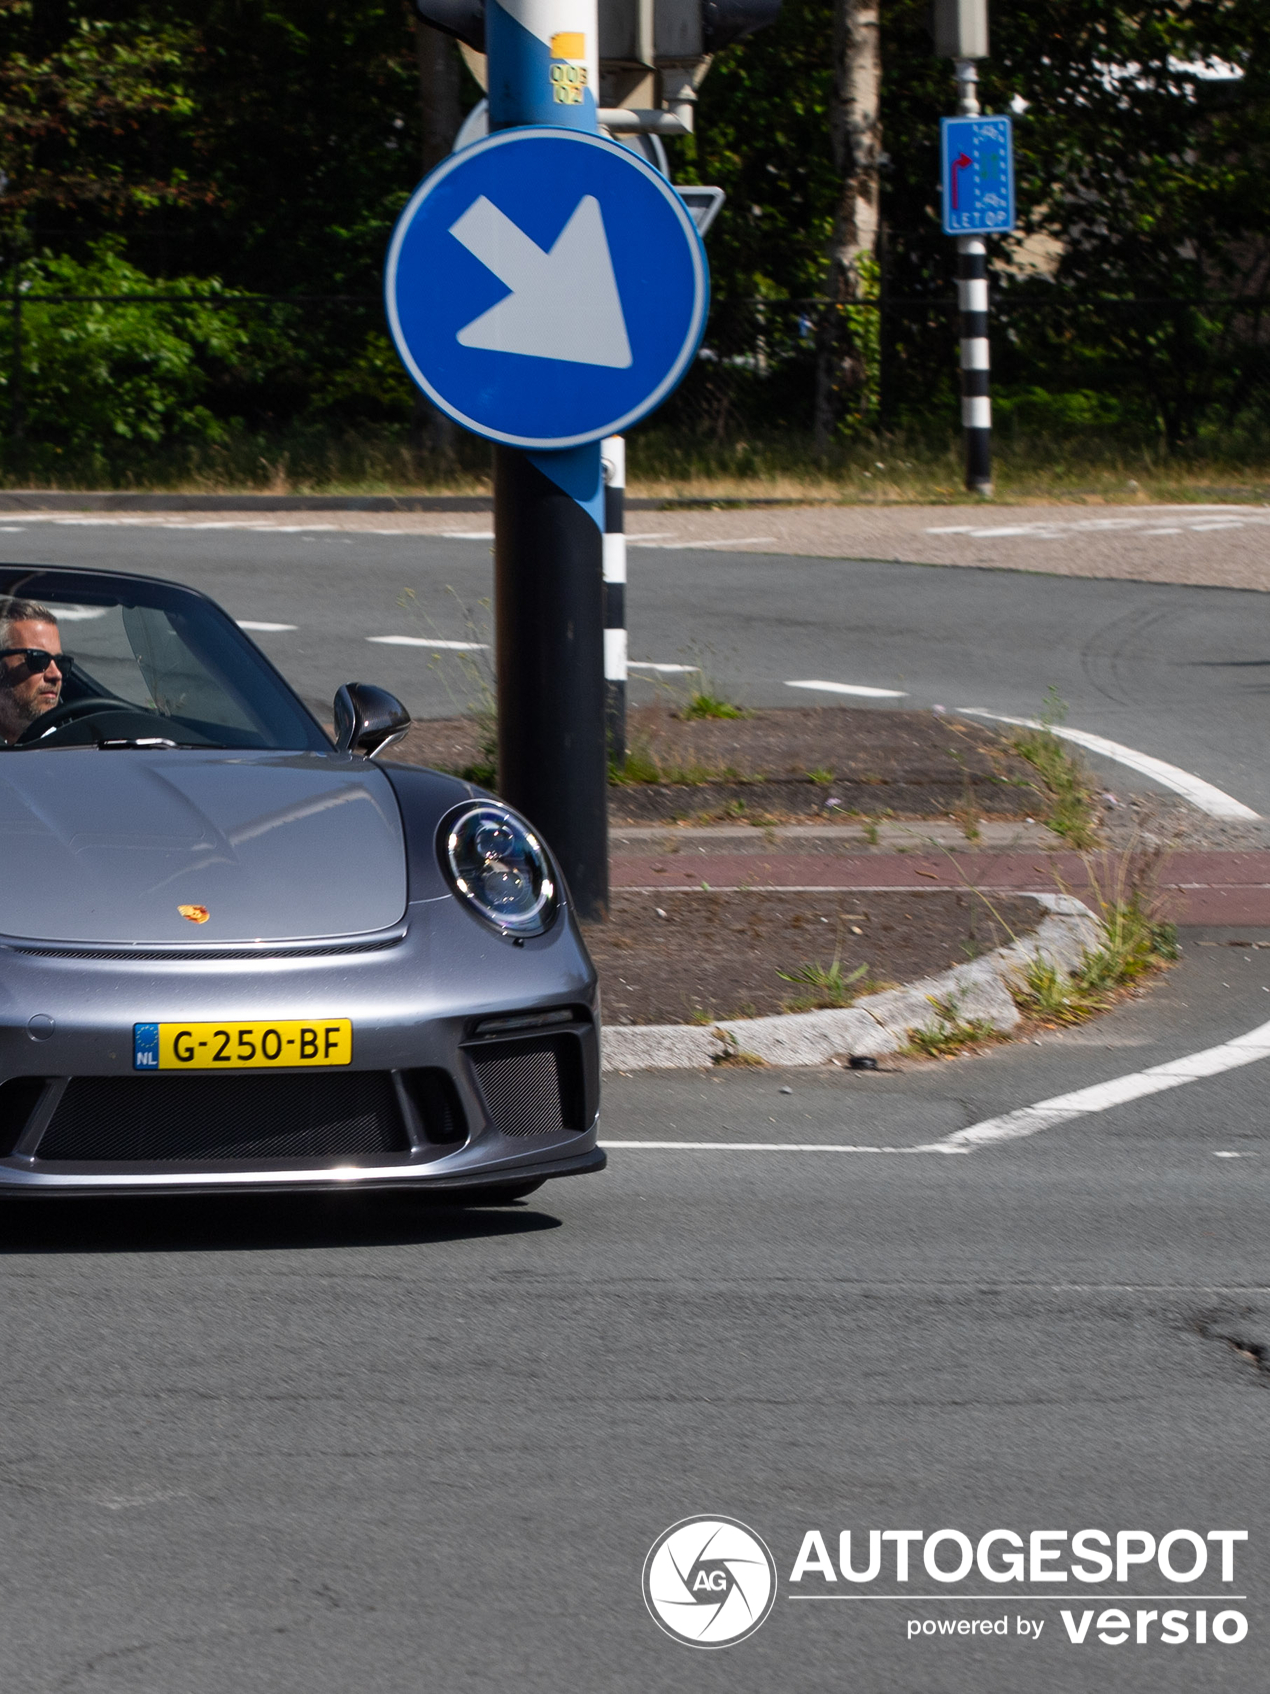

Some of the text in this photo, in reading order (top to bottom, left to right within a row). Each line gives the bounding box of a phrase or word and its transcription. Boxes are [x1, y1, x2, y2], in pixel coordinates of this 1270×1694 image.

[555, 85, 583, 104] 02
[952, 210, 1007, 228] LET OP
[136, 1027, 341, 1066] NL G-250-BF
